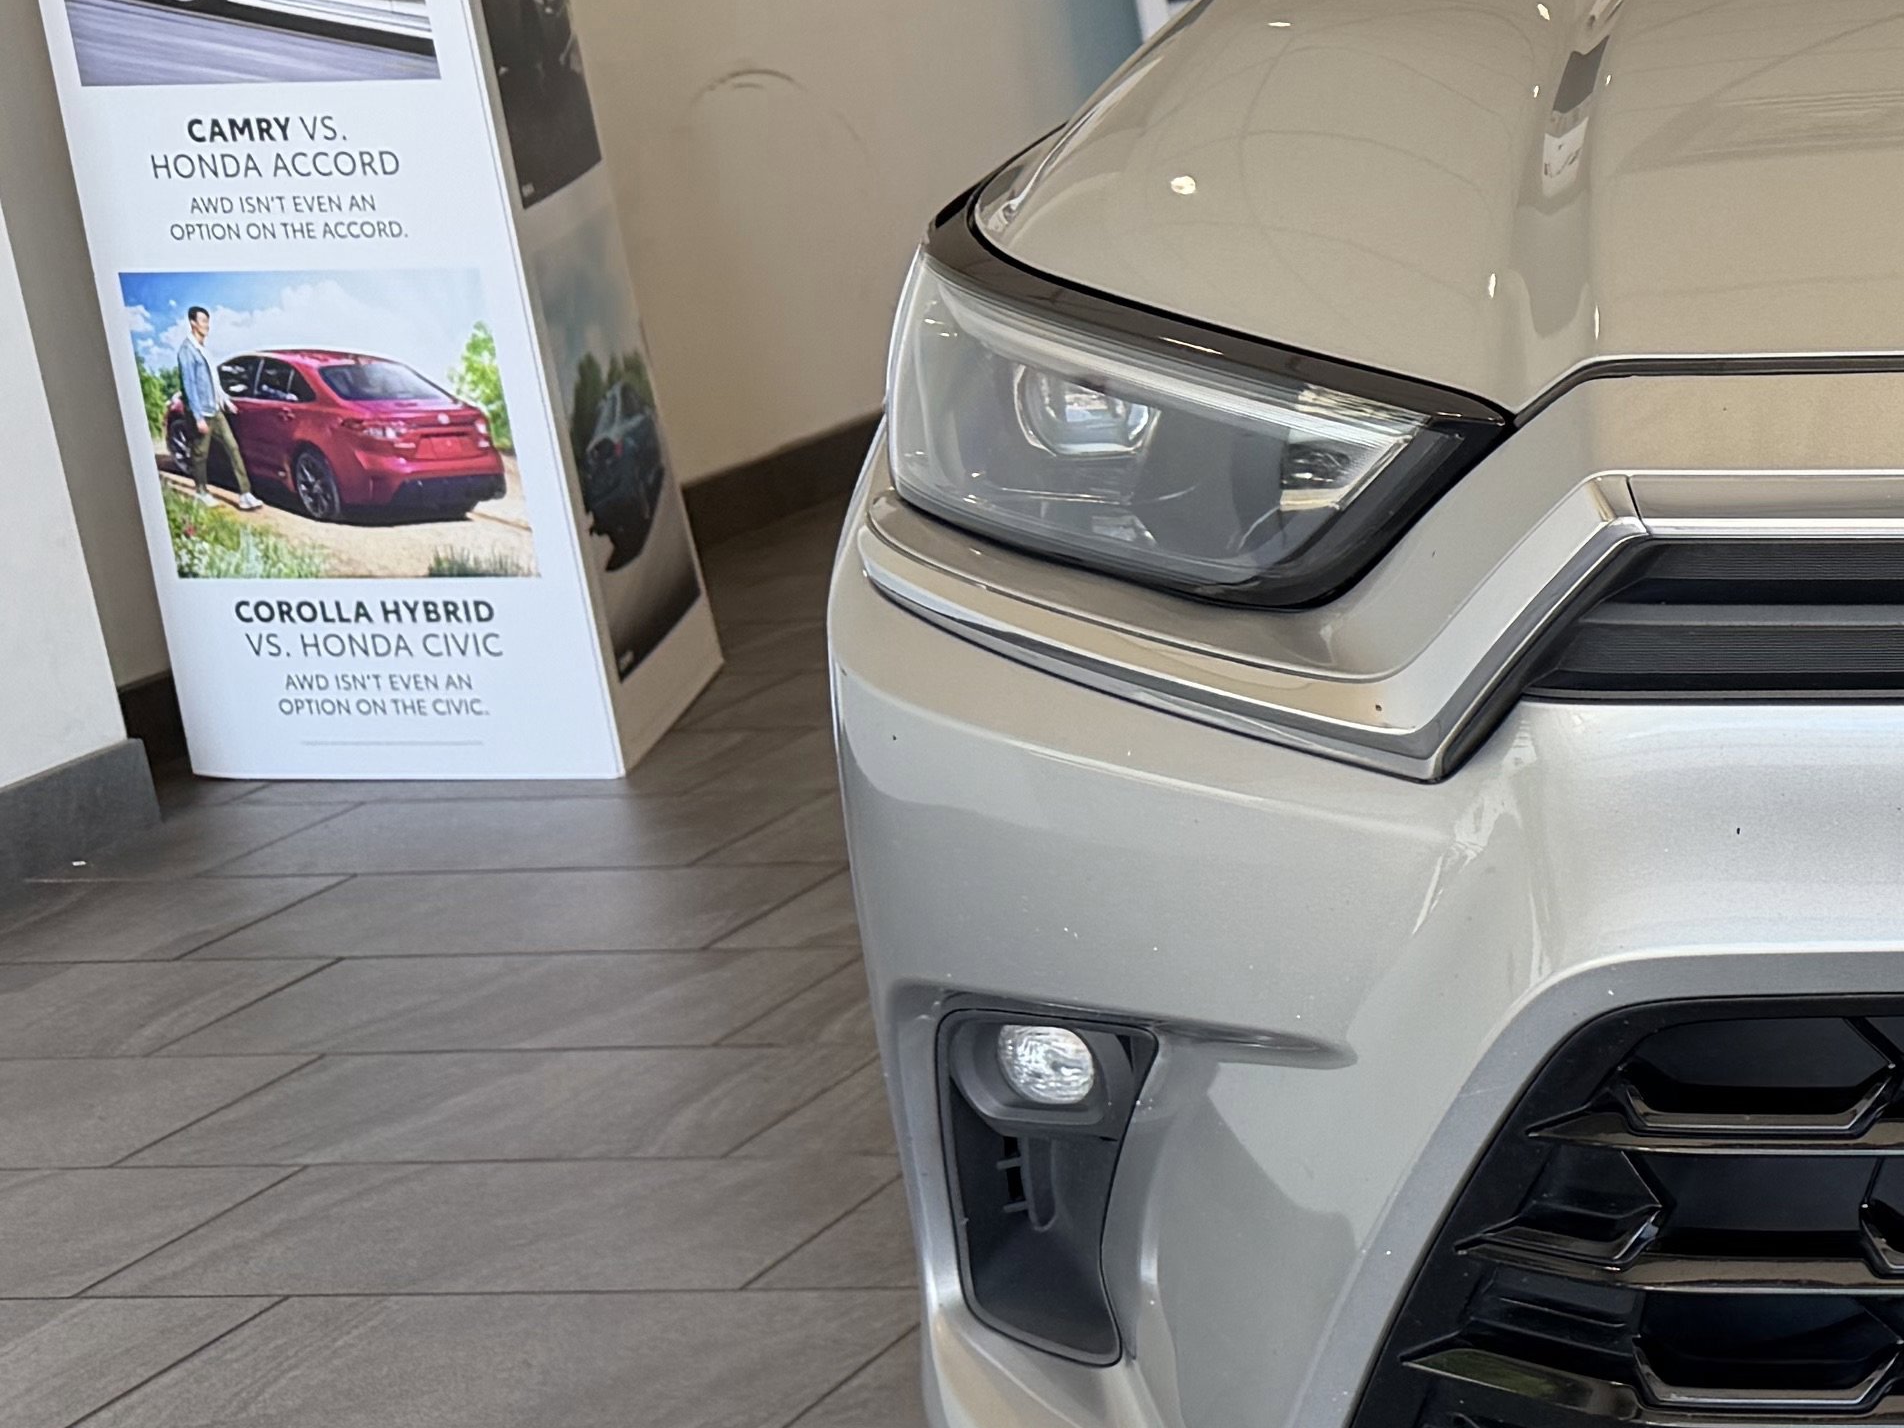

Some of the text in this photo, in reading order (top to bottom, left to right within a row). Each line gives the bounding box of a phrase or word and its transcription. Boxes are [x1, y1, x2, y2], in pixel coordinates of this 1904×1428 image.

[186, 116, 348, 143] CAMRY VS.
[150, 150, 400, 179] HONDA ACCORD
[190, 194, 376, 215] AWD ISN'T EVEN AN
[170, 221, 409, 241] OPTION ON THE ACCORD.
[234, 600, 495, 624] COROLLA HYBRID
[245, 632, 504, 657] VS. HONDA CIVIC
[285, 673, 473, 690] AWD ISN'T EVEN AN
[278, 698, 490, 716] OPTION ON THE CIVIC.
